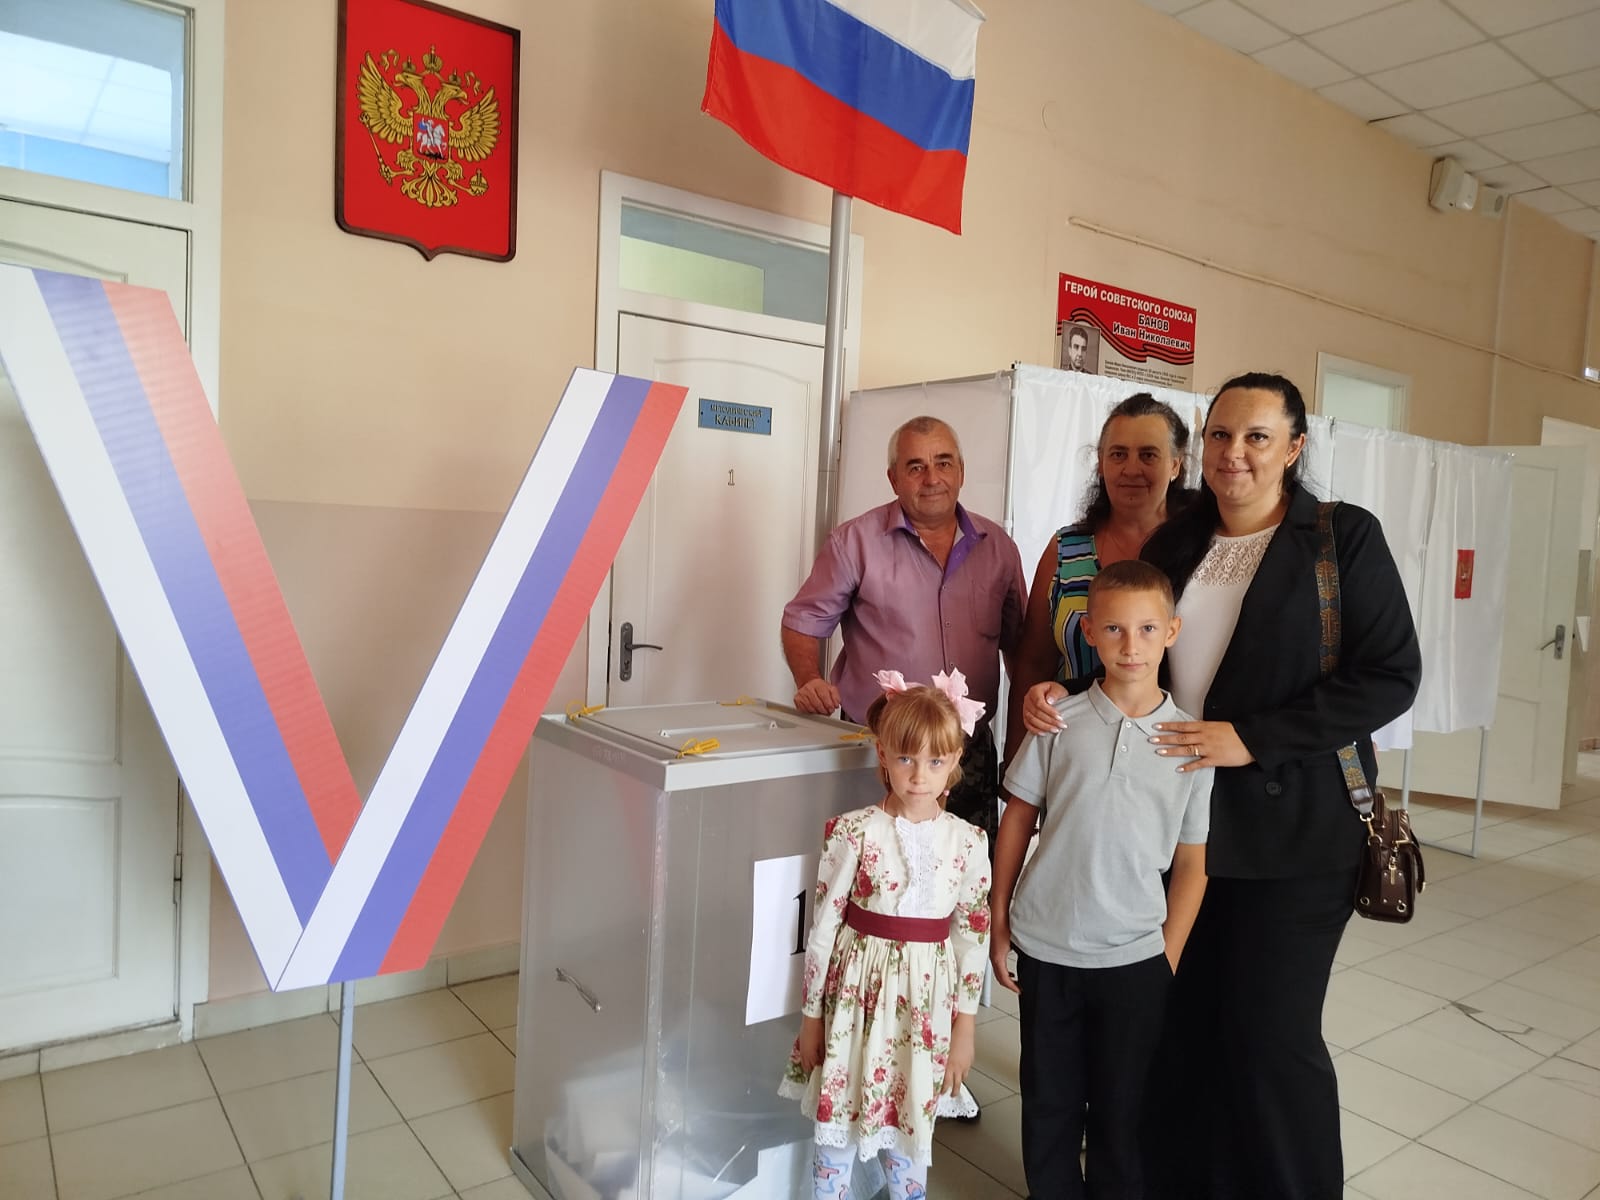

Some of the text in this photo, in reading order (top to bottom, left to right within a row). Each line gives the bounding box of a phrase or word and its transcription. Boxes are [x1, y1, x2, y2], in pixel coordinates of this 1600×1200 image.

[1065, 281, 1194, 324] ГЕРОЙ СОВЕТСКОГО СОЮЗА
[1138, 313, 1169, 332] БАНОВ
[1112, 321, 1191, 351] Иван Николаевич
[715, 414, 755, 429] КАБИНЕТ
[727, 468, 735, 486] 1
[790, 888, 807, 956] 1
